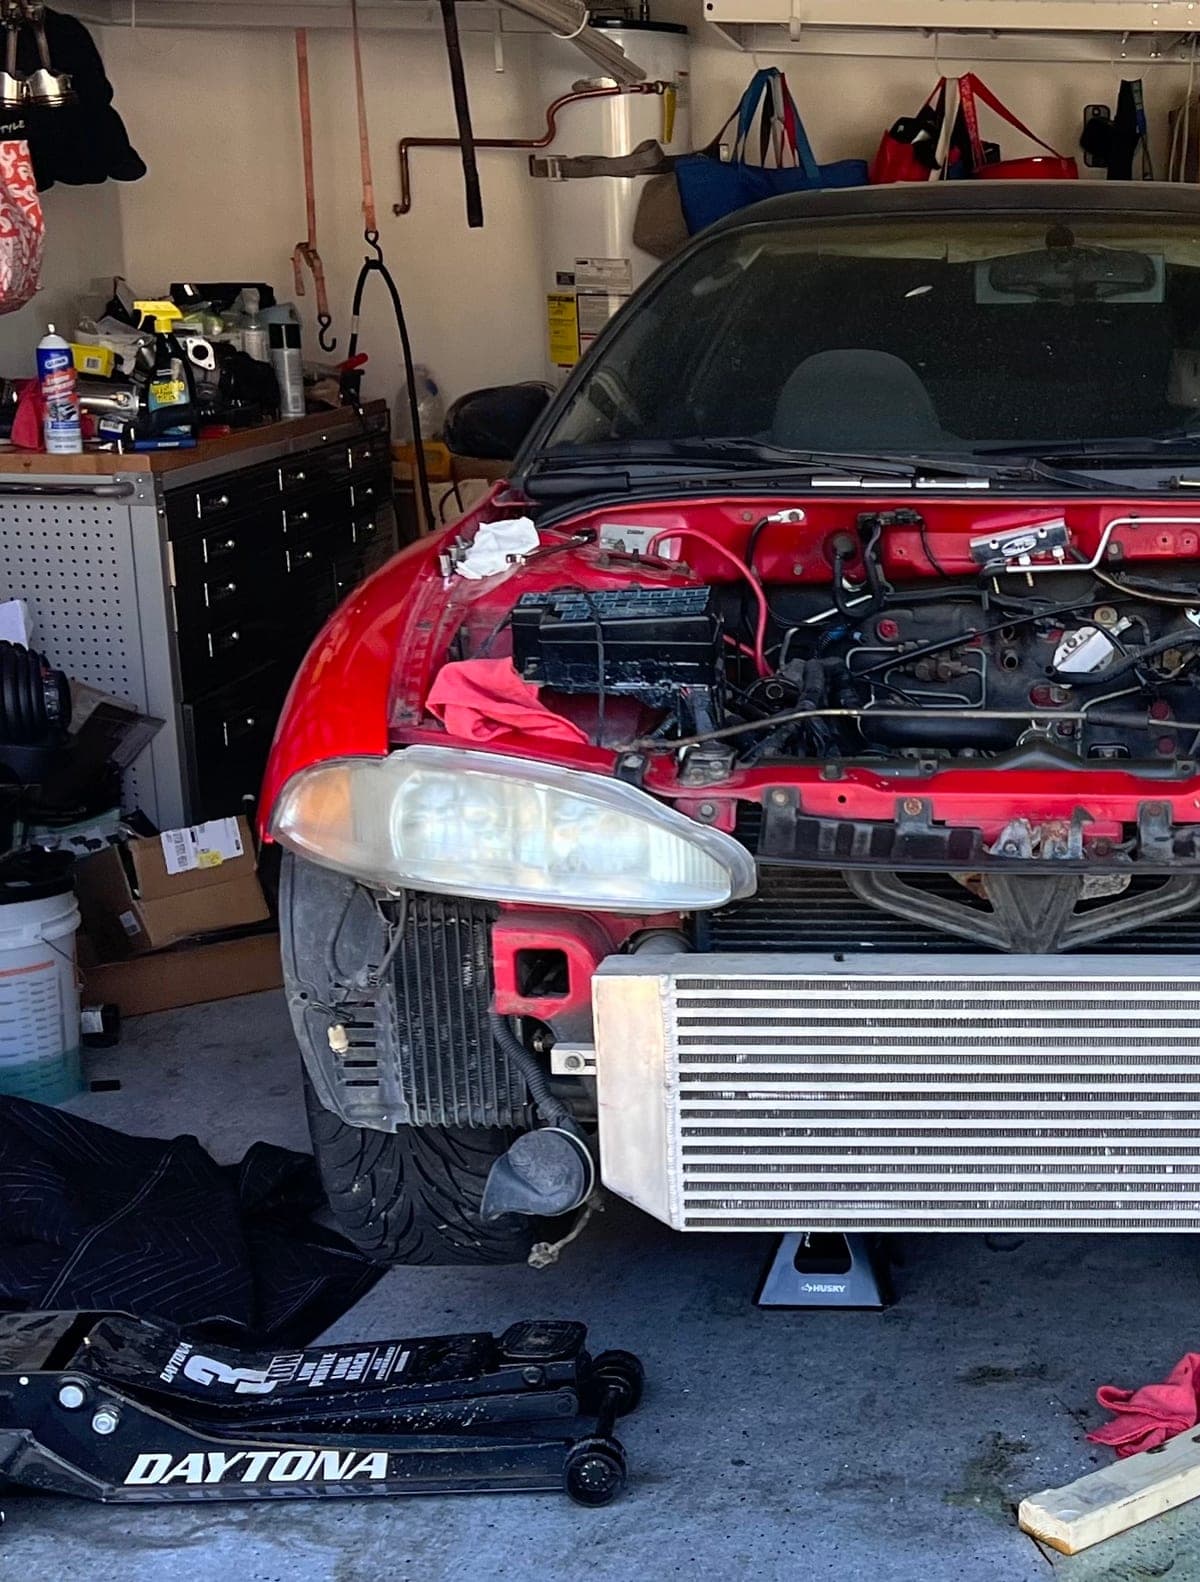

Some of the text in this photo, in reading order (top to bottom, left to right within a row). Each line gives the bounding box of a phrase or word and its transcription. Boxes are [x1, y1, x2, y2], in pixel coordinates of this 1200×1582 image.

[813, 1284, 846, 1293] HUSKY
[160, 1341, 193, 1383] DAYTONA
[183, 1354, 278, 1394] 3
[123, 1450, 389, 1485] DAYTONA
